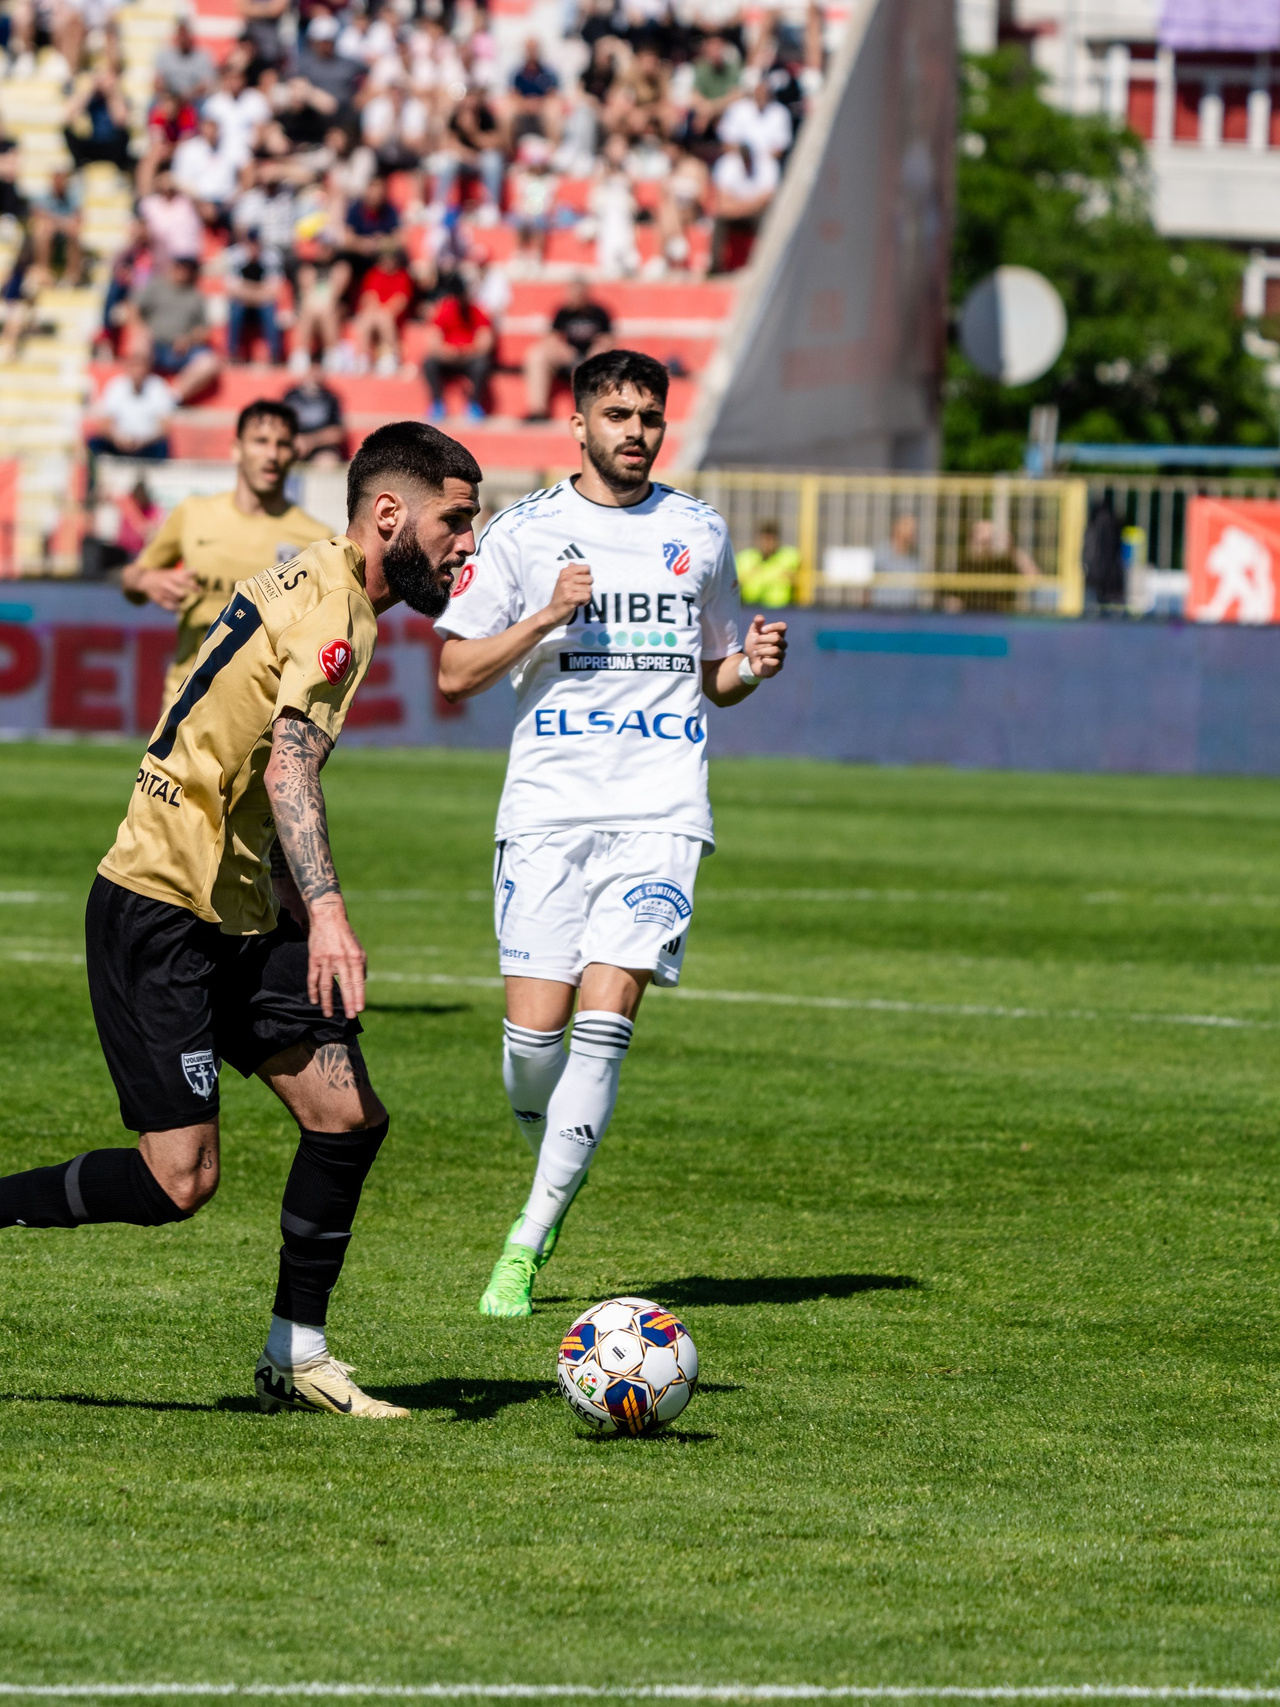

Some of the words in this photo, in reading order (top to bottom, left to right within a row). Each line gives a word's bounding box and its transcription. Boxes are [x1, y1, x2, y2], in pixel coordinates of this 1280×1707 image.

[147, 590, 264, 762] 7
[568, 652, 636, 671] ÎMPREUNĂ
[636, 655, 671, 671] SPRE
[672, 656, 692, 672] 0%
[535, 708, 706, 744] ELSACO
[625, 887, 645, 905] FIVE
[645, 885, 690, 915] CONTINENTS
[559, 1129, 598, 1148] adidas
[558, 1372, 607, 1429] SELECT
[577, 1379, 593, 1395] LPF
